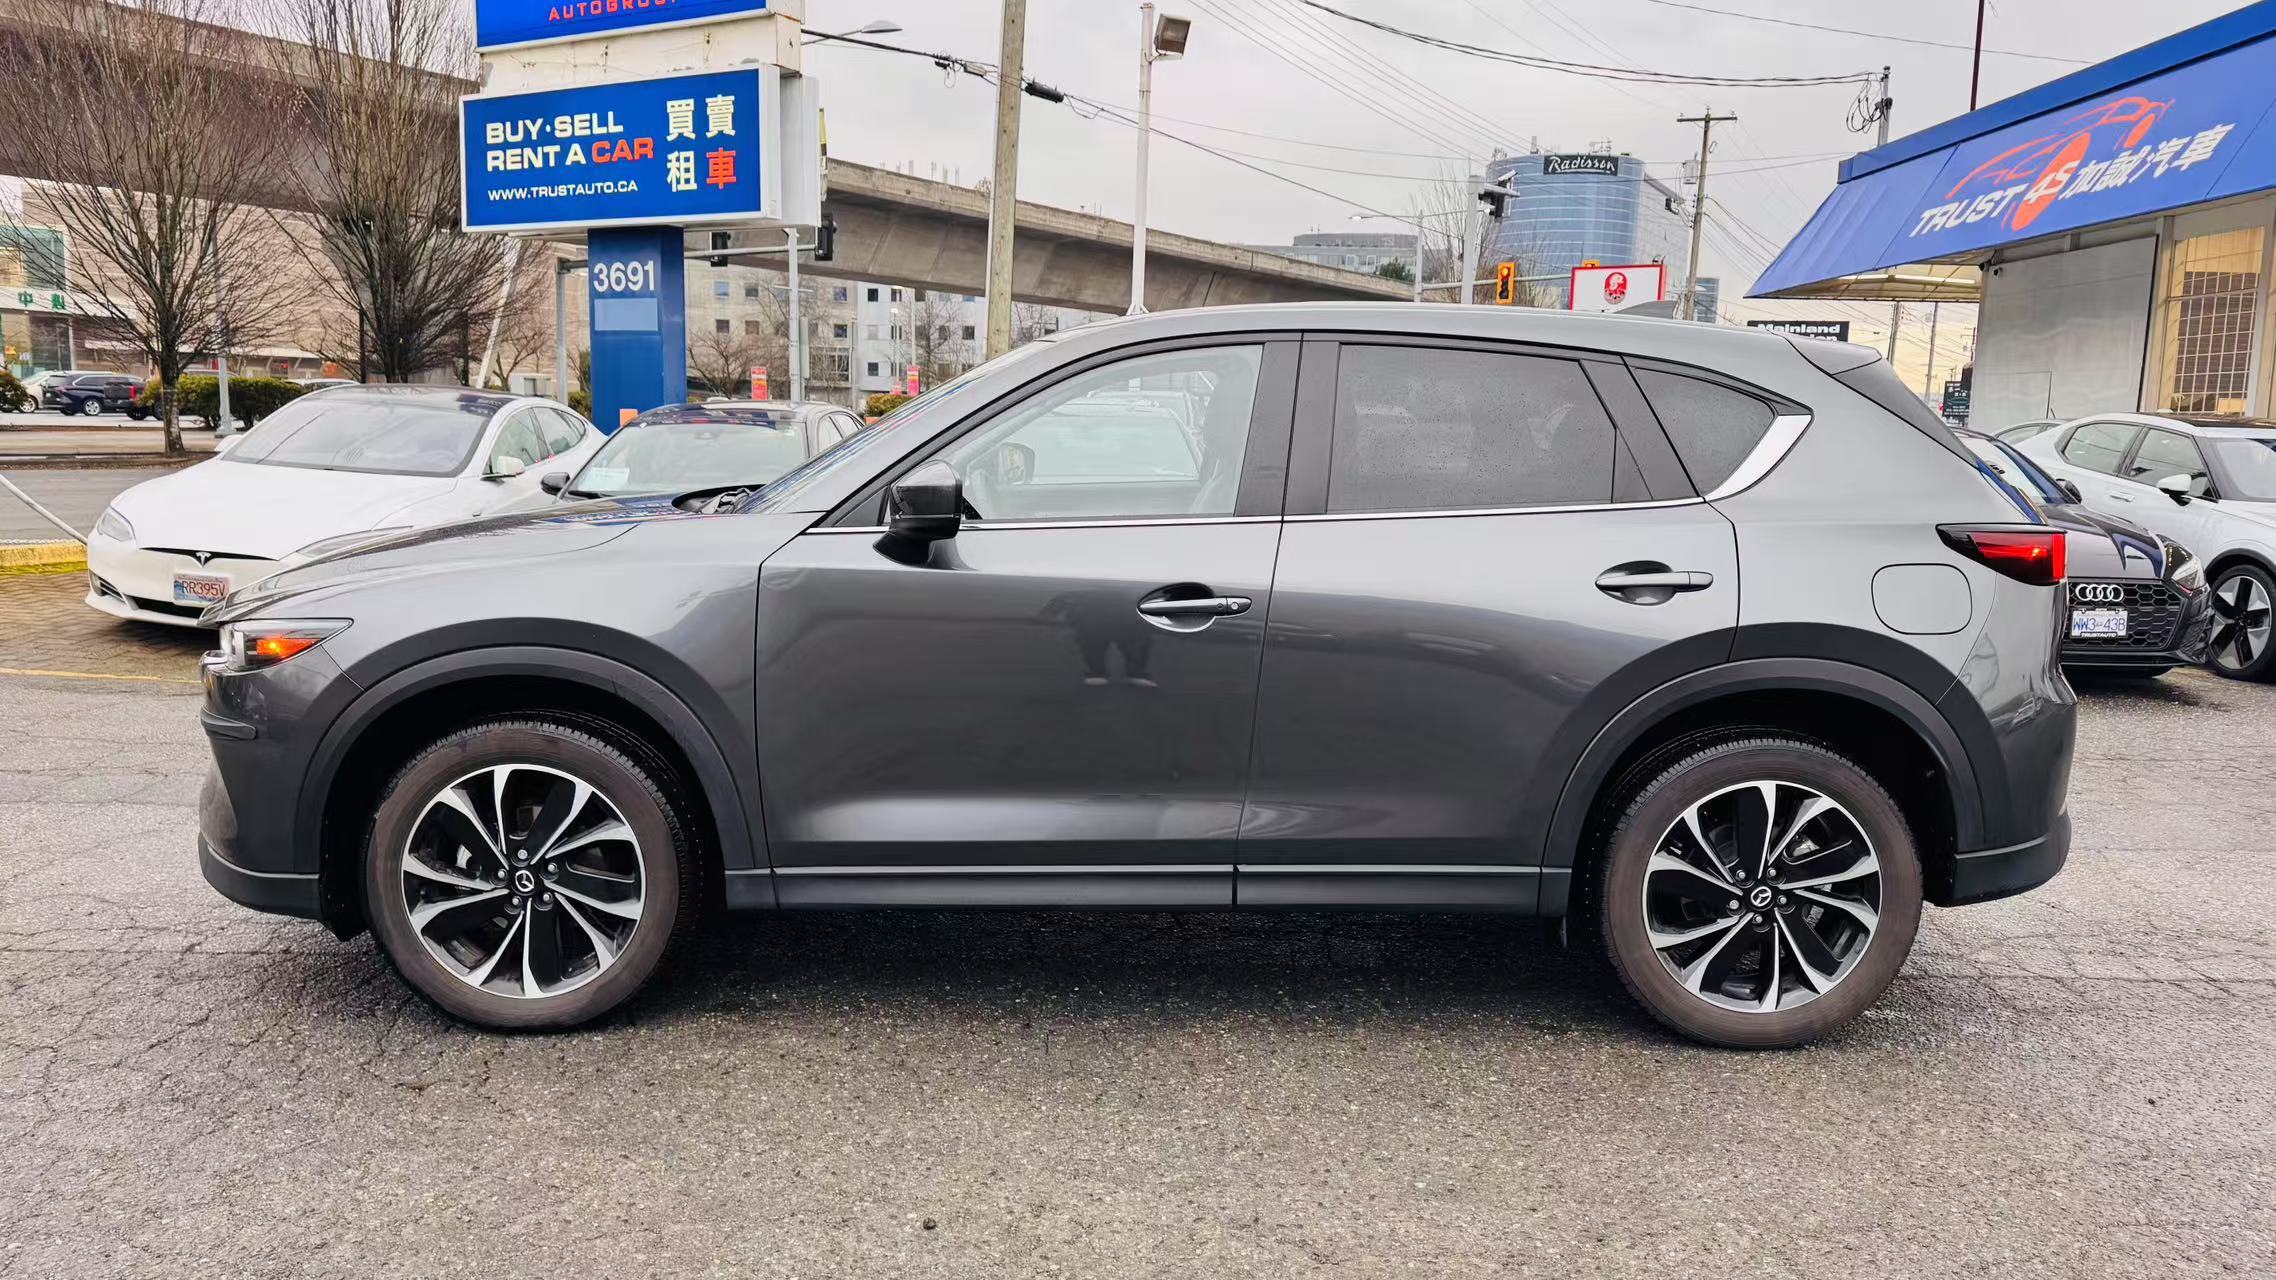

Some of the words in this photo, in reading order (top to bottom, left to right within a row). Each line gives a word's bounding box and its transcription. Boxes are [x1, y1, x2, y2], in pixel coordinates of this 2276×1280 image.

[548, 0, 676, 21] AUTOGRO
[487, 145, 561, 172] RENT
[565, 143, 587, 166] A
[592, 137, 654, 163] CAR
[1548, 156, 1615, 173] Radisson
[488, 180, 638, 201] WWW.TRUSTAUTO.CA
[1909, 183, 2028, 237] TRUST
[593, 260, 655, 292] 3691
[1757, 323, 1841, 335] Mainland
